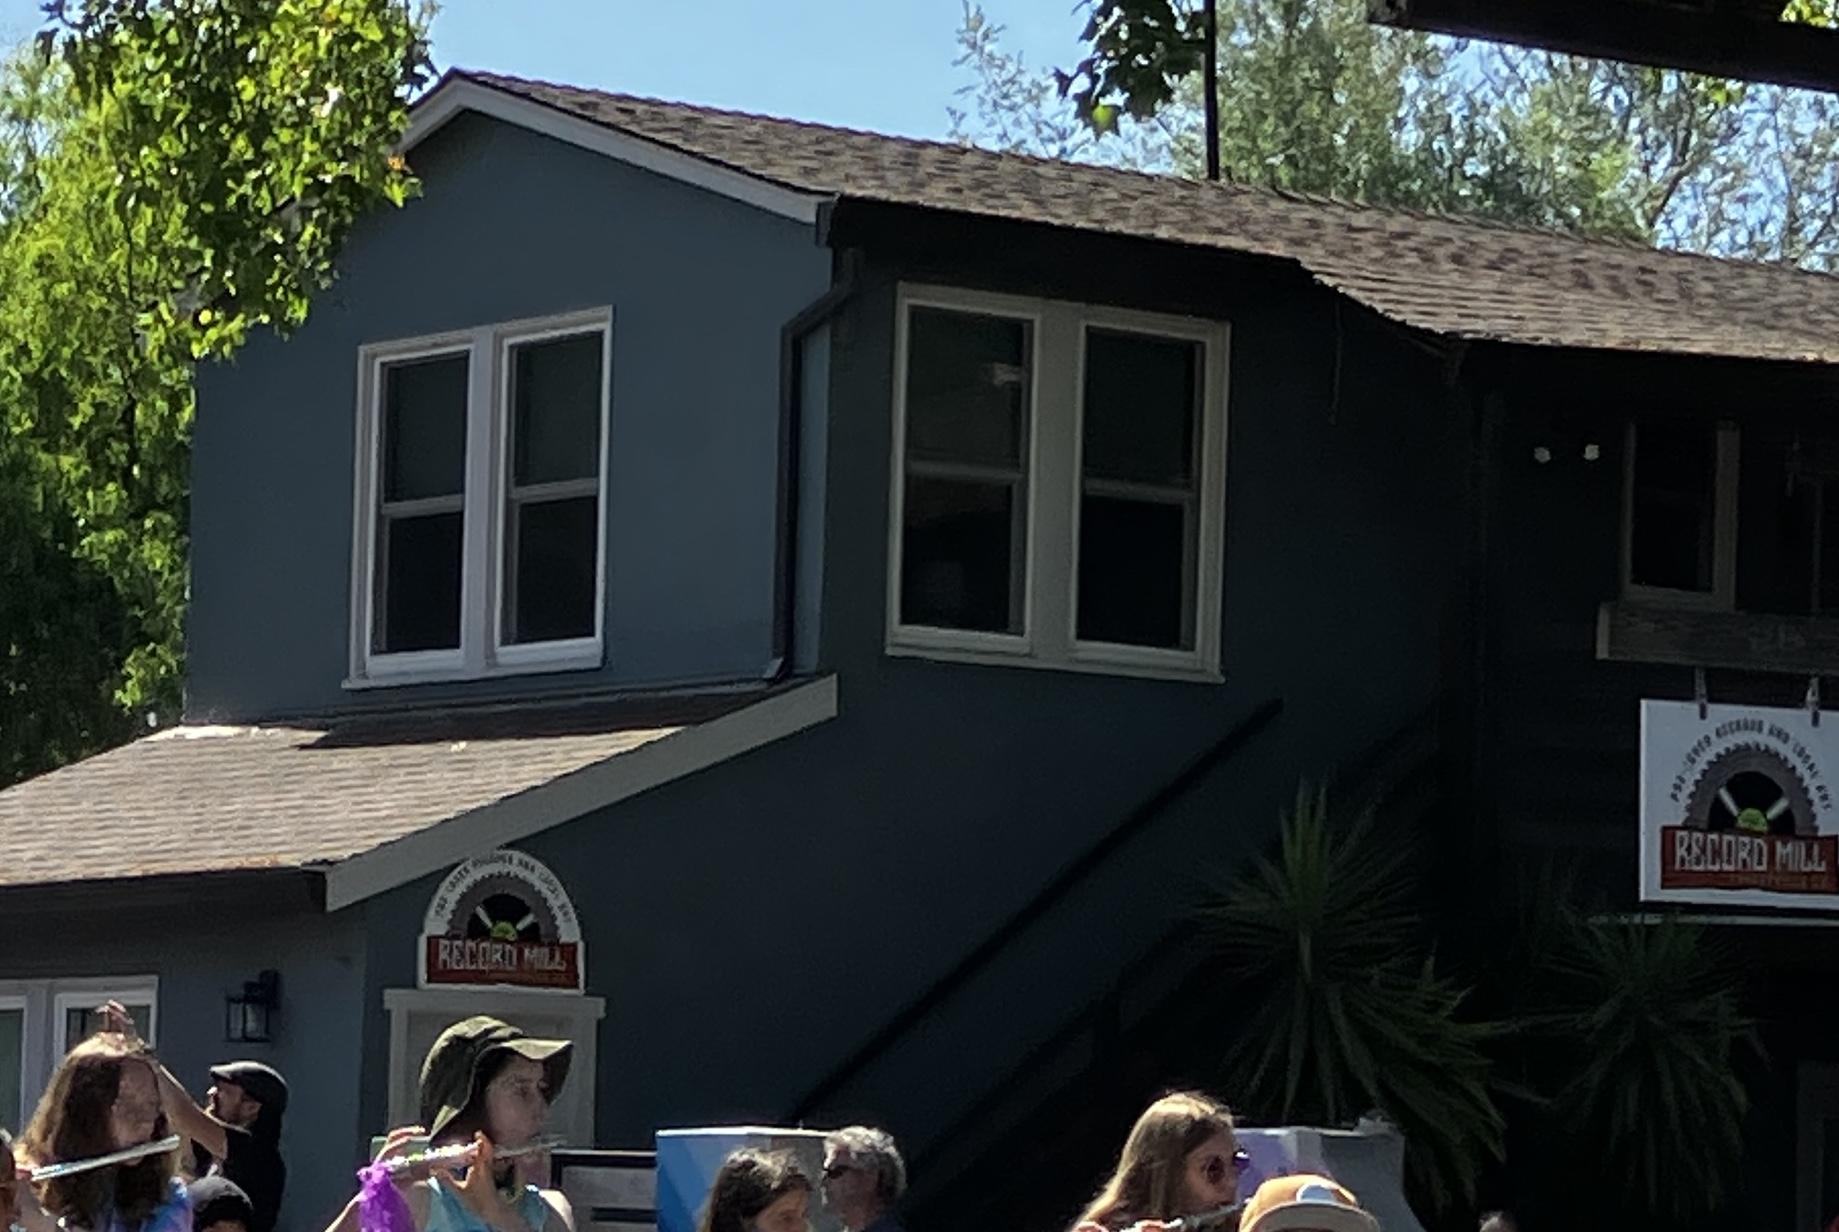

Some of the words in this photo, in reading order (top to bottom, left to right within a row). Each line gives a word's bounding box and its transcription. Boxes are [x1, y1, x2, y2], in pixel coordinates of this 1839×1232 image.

[1674, 830, 1768, 872] RECORD
[1775, 839, 1827, 873] MILL
[438, 939, 518, 970] RECORD
[524, 945, 567, 971] MILL
